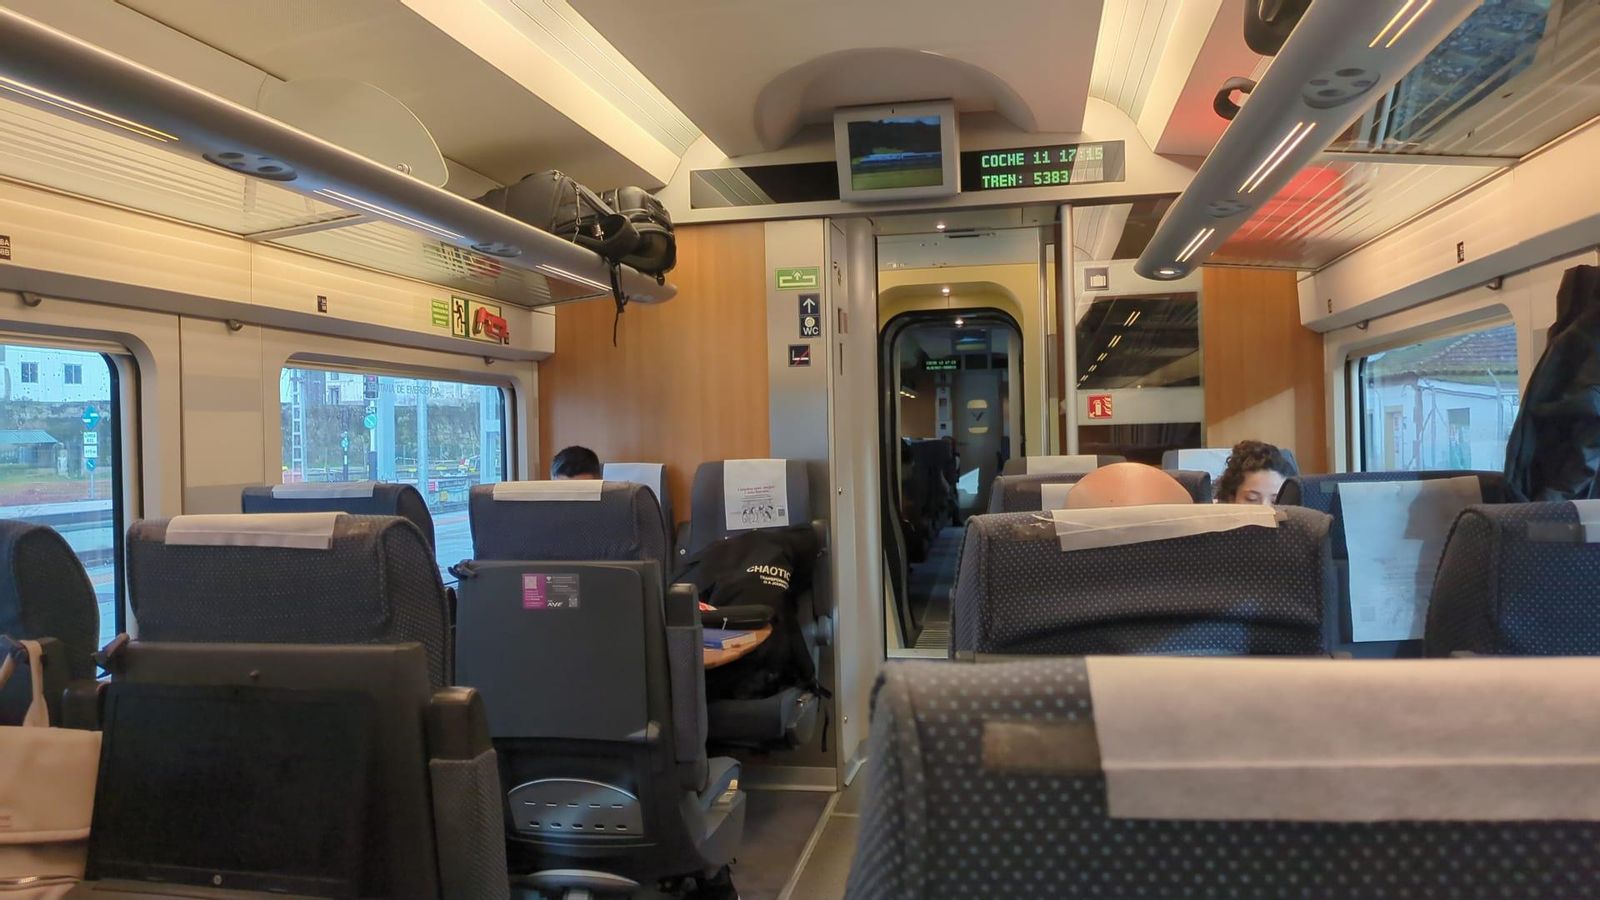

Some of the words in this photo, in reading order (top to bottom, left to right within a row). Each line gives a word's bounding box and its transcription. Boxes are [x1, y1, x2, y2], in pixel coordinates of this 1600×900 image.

[981, 152, 1025, 168] COCHE
[1033, 150, 1051, 165] 11
[982, 173, 1023, 188] TREN:
[1033, 169, 1070, 185] 5383
[803, 327, 819, 335] WC
[746, 565, 791, 581] CHAOTIC
